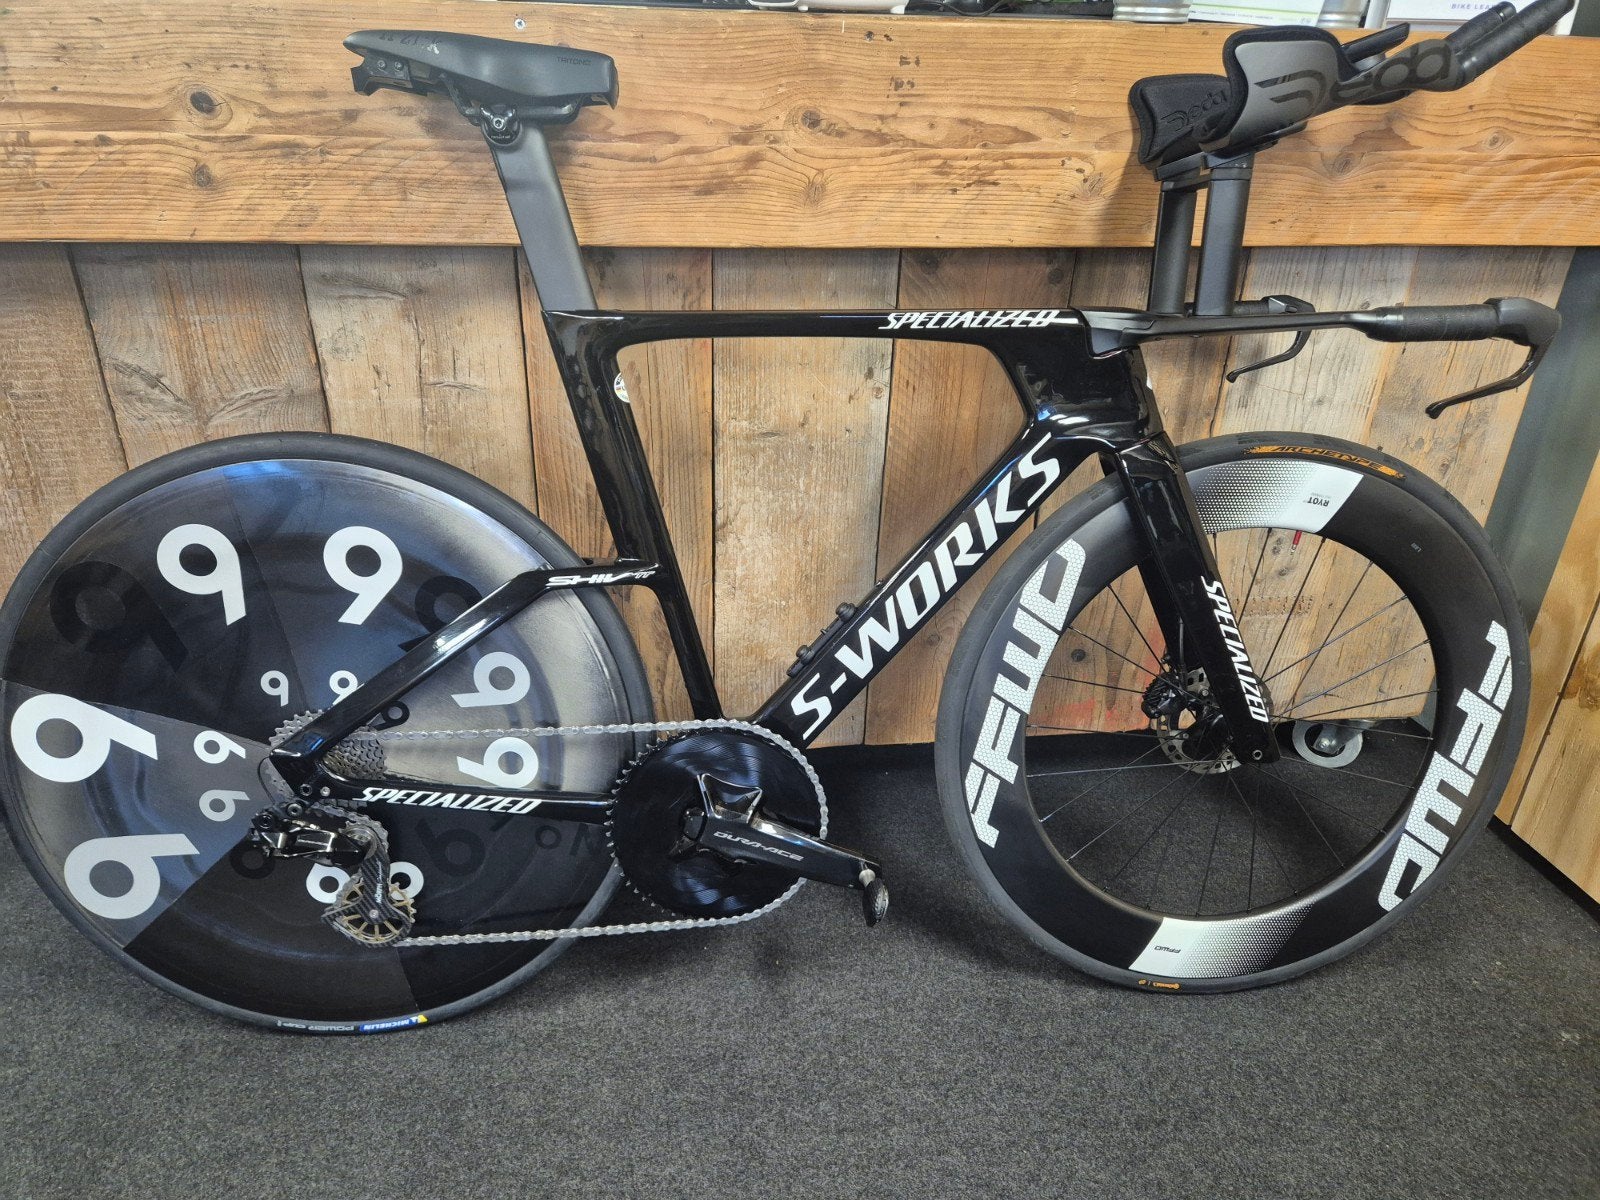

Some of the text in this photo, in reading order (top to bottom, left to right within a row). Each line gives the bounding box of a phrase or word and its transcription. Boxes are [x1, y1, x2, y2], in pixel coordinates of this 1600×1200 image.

[1451, 2, 1471, 10] BIKE
[878, 308, 1062, 330] SPECIALIZED
[1307, 496, 1330, 507] RYOT
[323, 526, 403, 625] 9
[790, 432, 1061, 740] S-WORKS
[1201, 574, 1268, 723] SPECIALIZED
[353, 786, 541, 815] SPECIALIZED
[713, 830, 804, 861] DURA-ACE
[363, 1019, 410, 1031] MICHELIN
